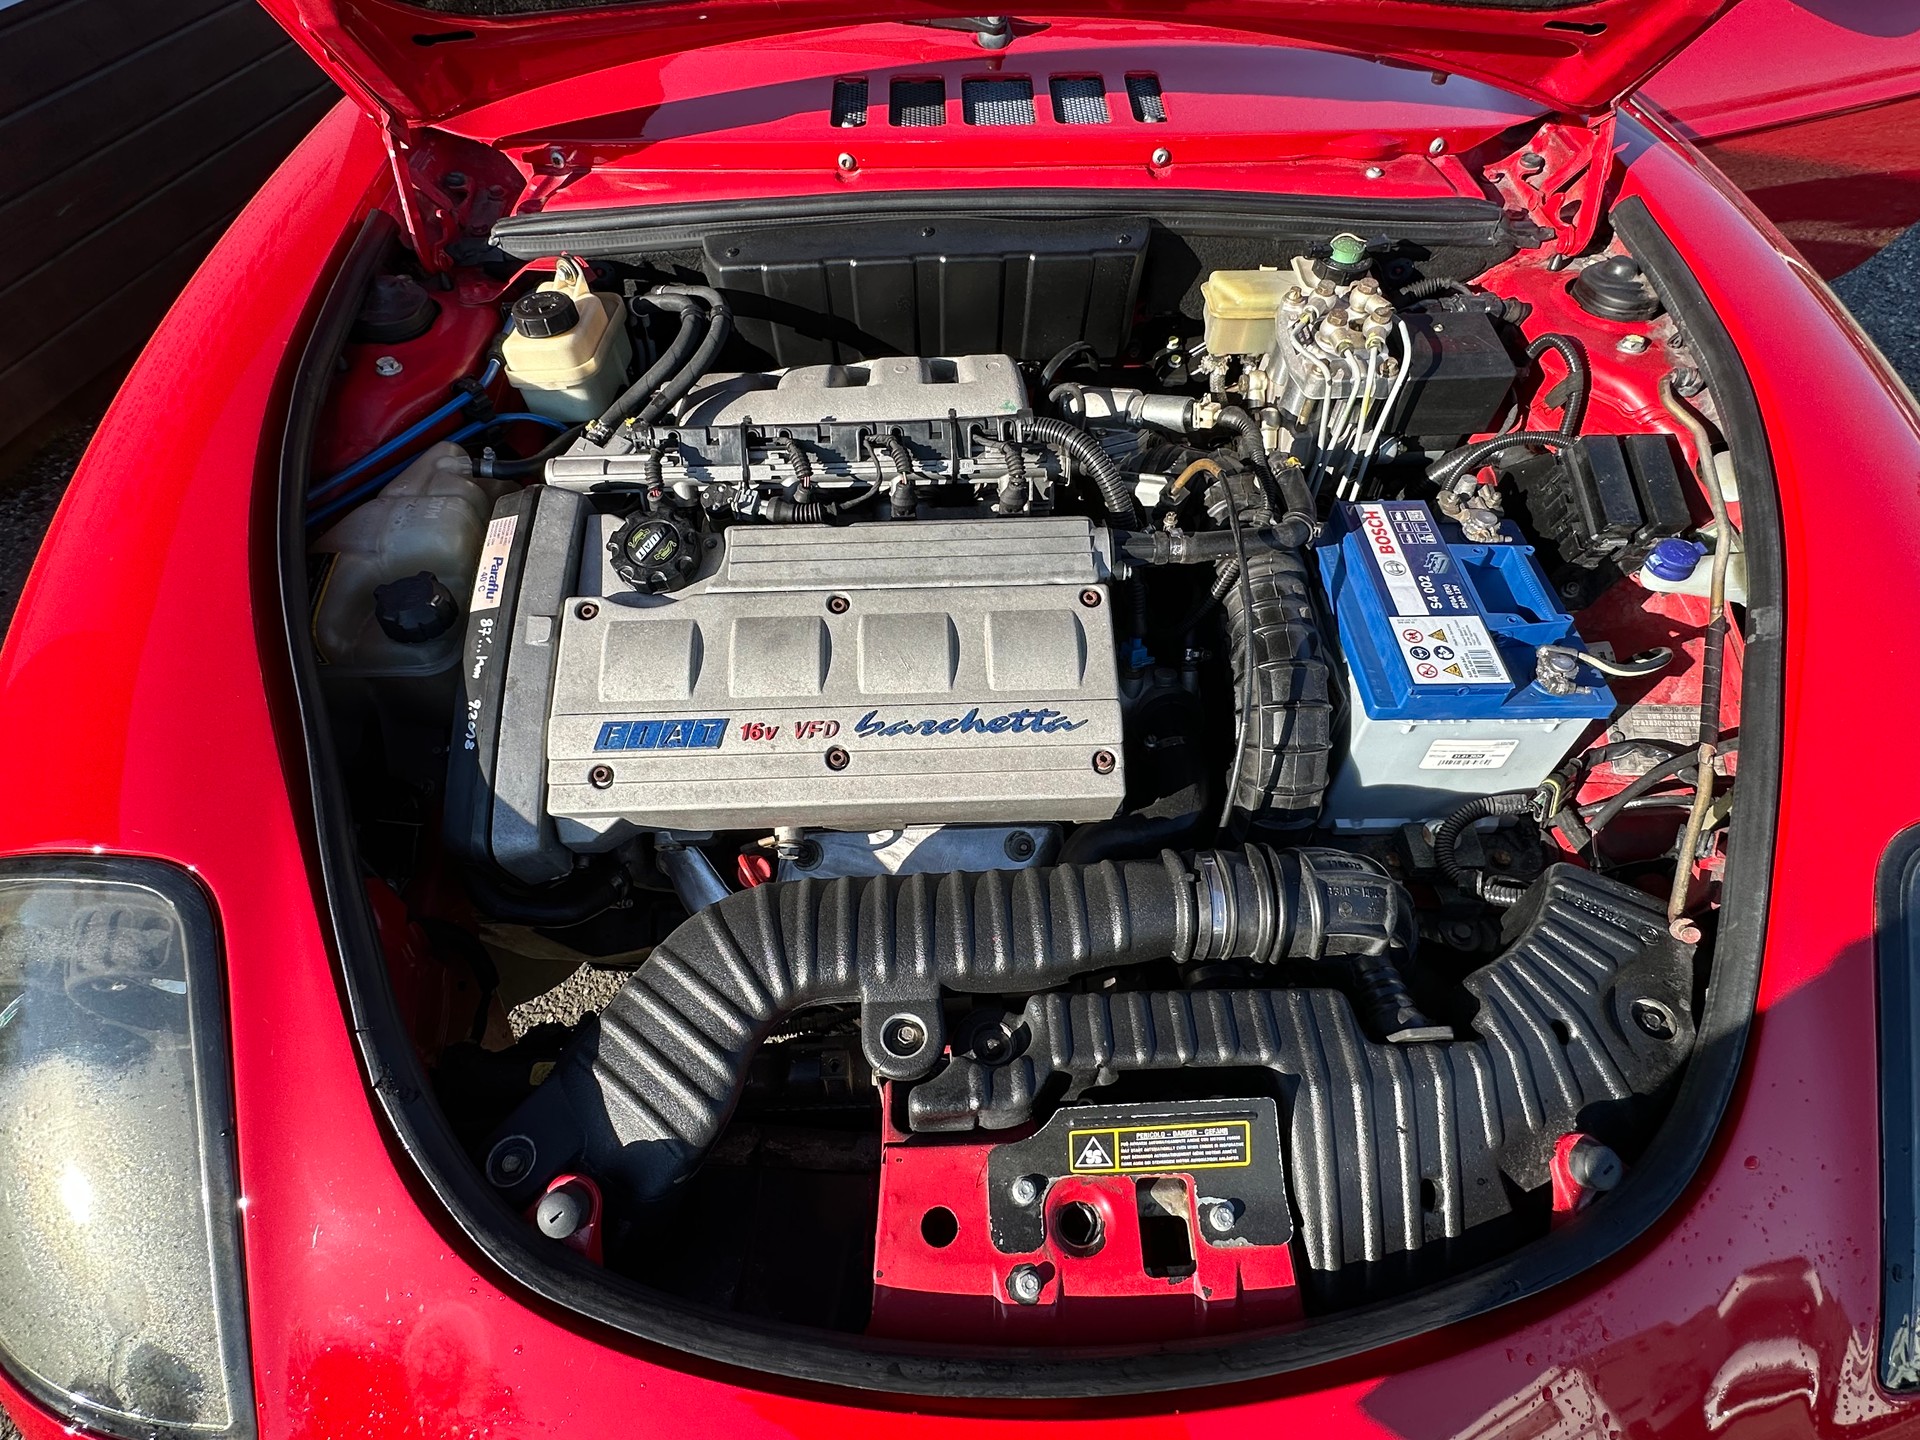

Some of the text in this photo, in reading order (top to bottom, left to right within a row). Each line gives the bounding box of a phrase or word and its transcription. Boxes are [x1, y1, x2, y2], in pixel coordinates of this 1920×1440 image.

[1367, 510, 1396, 555] BOSCH
[486, 556, 504, 600] Paraflu
[1418, 575, 1443, 609] S4 002
[597, 708, 1089, 749] FIAT 16v VFD barchetta
[1136, 1131, 1166, 1140] PERICOLO
[1173, 1129, 1198, 1138] DANGER
